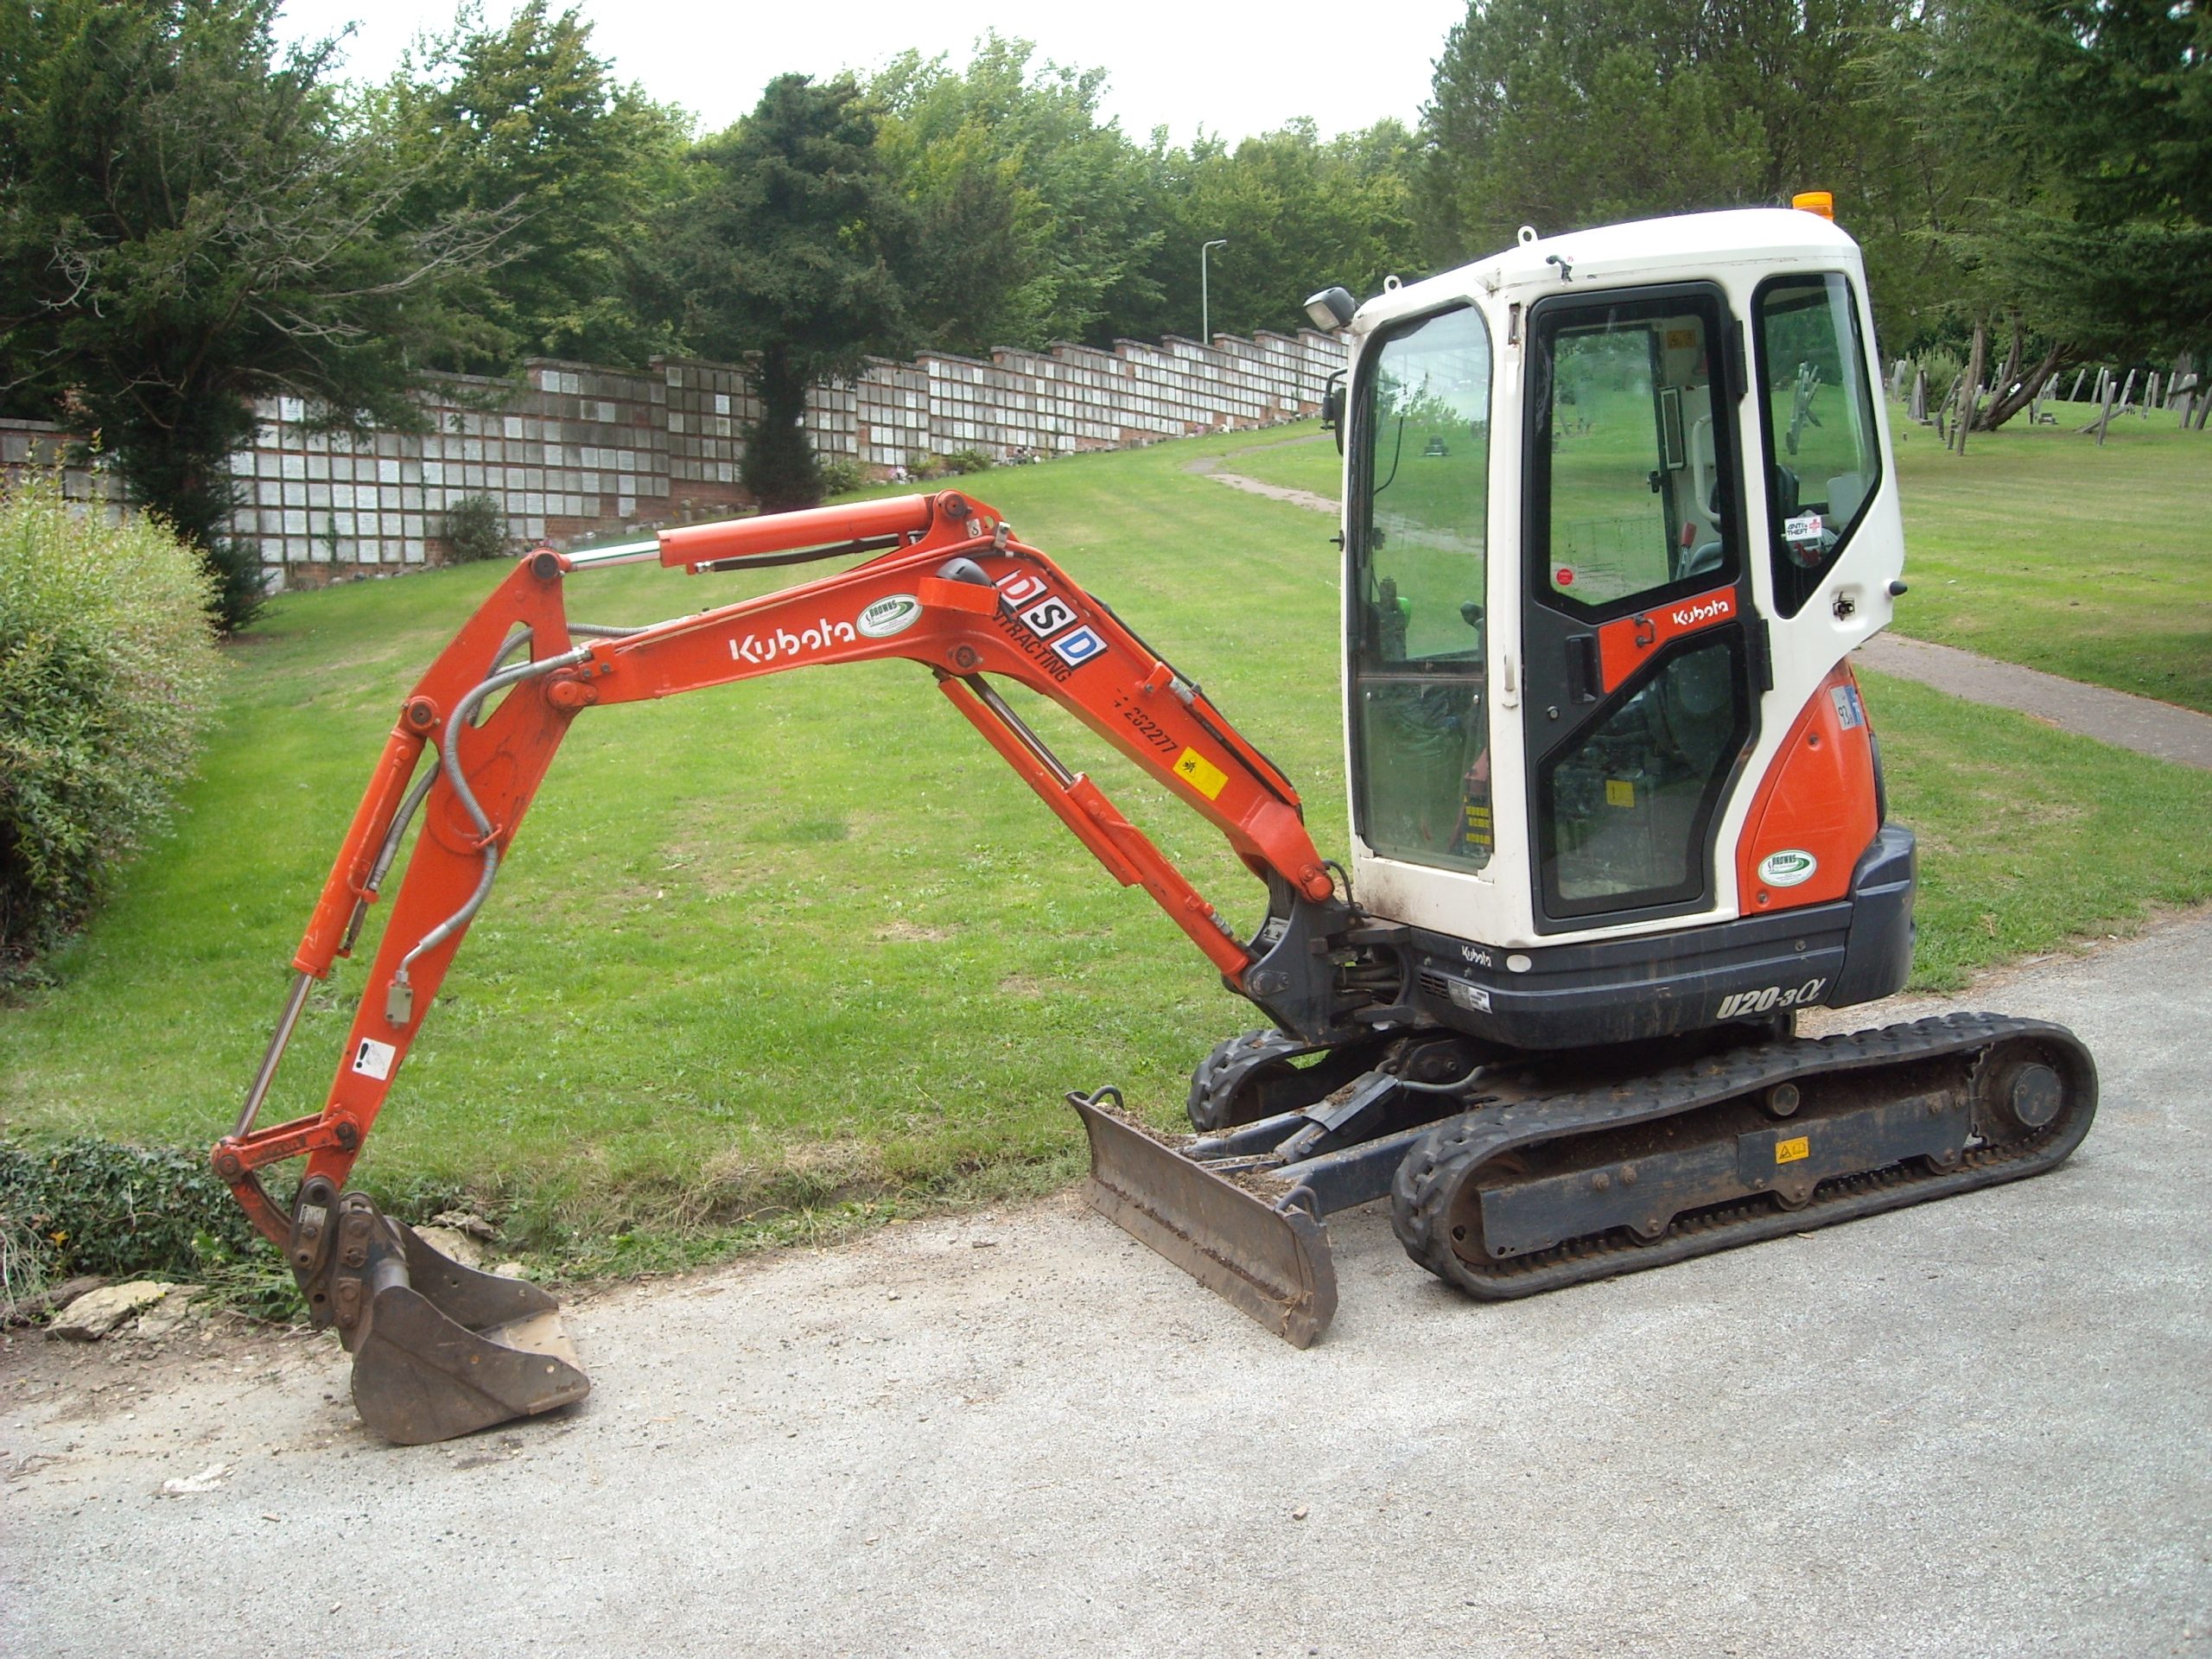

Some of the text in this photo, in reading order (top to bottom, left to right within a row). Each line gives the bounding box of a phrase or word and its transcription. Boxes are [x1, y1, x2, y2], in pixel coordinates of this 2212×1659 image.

[1672, 600, 1729, 626] Kubota
[728, 618, 856, 664] Kubota
[993, 610, 1072, 683] NTRACTING
[1461, 944, 1492, 968] Kubota
